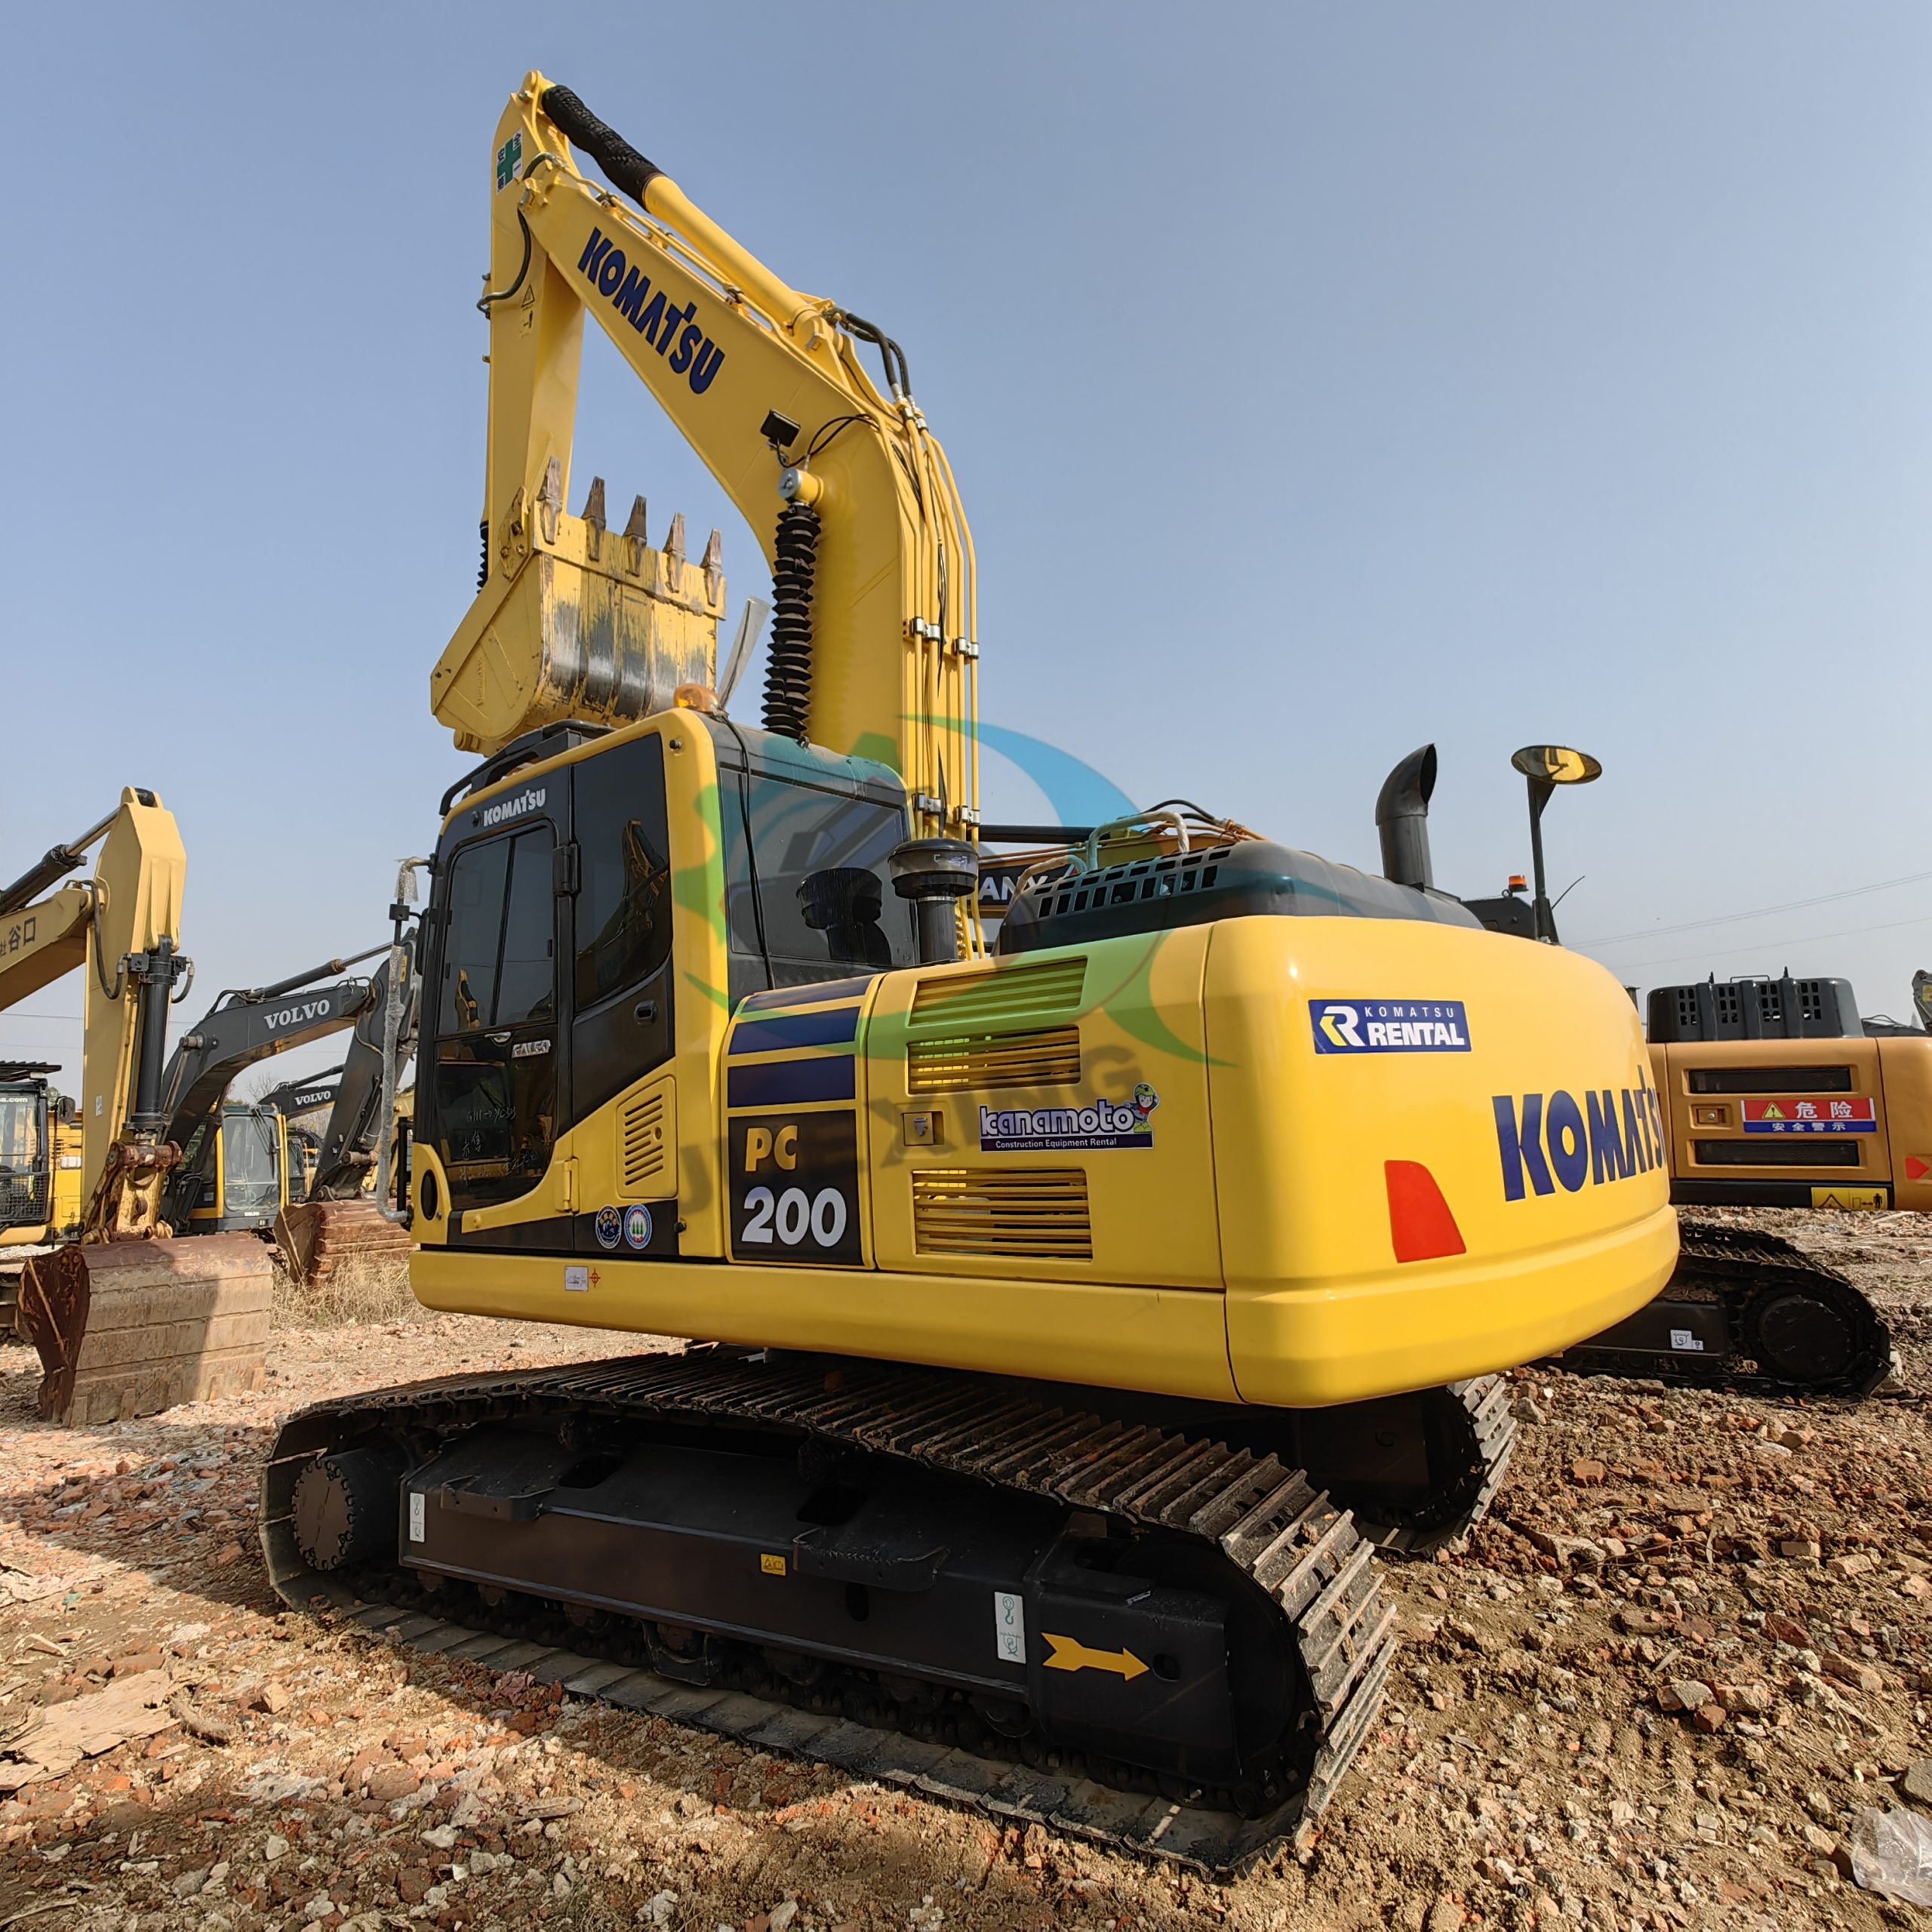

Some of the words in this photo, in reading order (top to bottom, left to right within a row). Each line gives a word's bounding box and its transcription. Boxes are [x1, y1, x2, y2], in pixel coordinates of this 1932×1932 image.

[577, 226, 725, 394] KOMATSU
[484, 788, 546, 827] KOMATSU
[264, 999, 330, 1029] VOLVO
[1364, 1006, 1454, 1018] KOMATSU
[1367, 1022, 1466, 1046] RENTAL
[295, 1090, 331, 1106] VOLVO
[1795, 1100, 1854, 1119] 危险
[979, 1098, 1135, 1137] kanamoto
[1771, 1121, 1847, 1132] 安全警示
[745, 1124, 798, 1172] PC
[995, 1140, 1044, 1149] Construction
[1045, 1138, 1088, 1149] Equipment
[1090, 1137, 1117, 1146] Rental
[1491, 1064, 1666, 1202] KOMATS
[741, 1186, 848, 1247] 200
